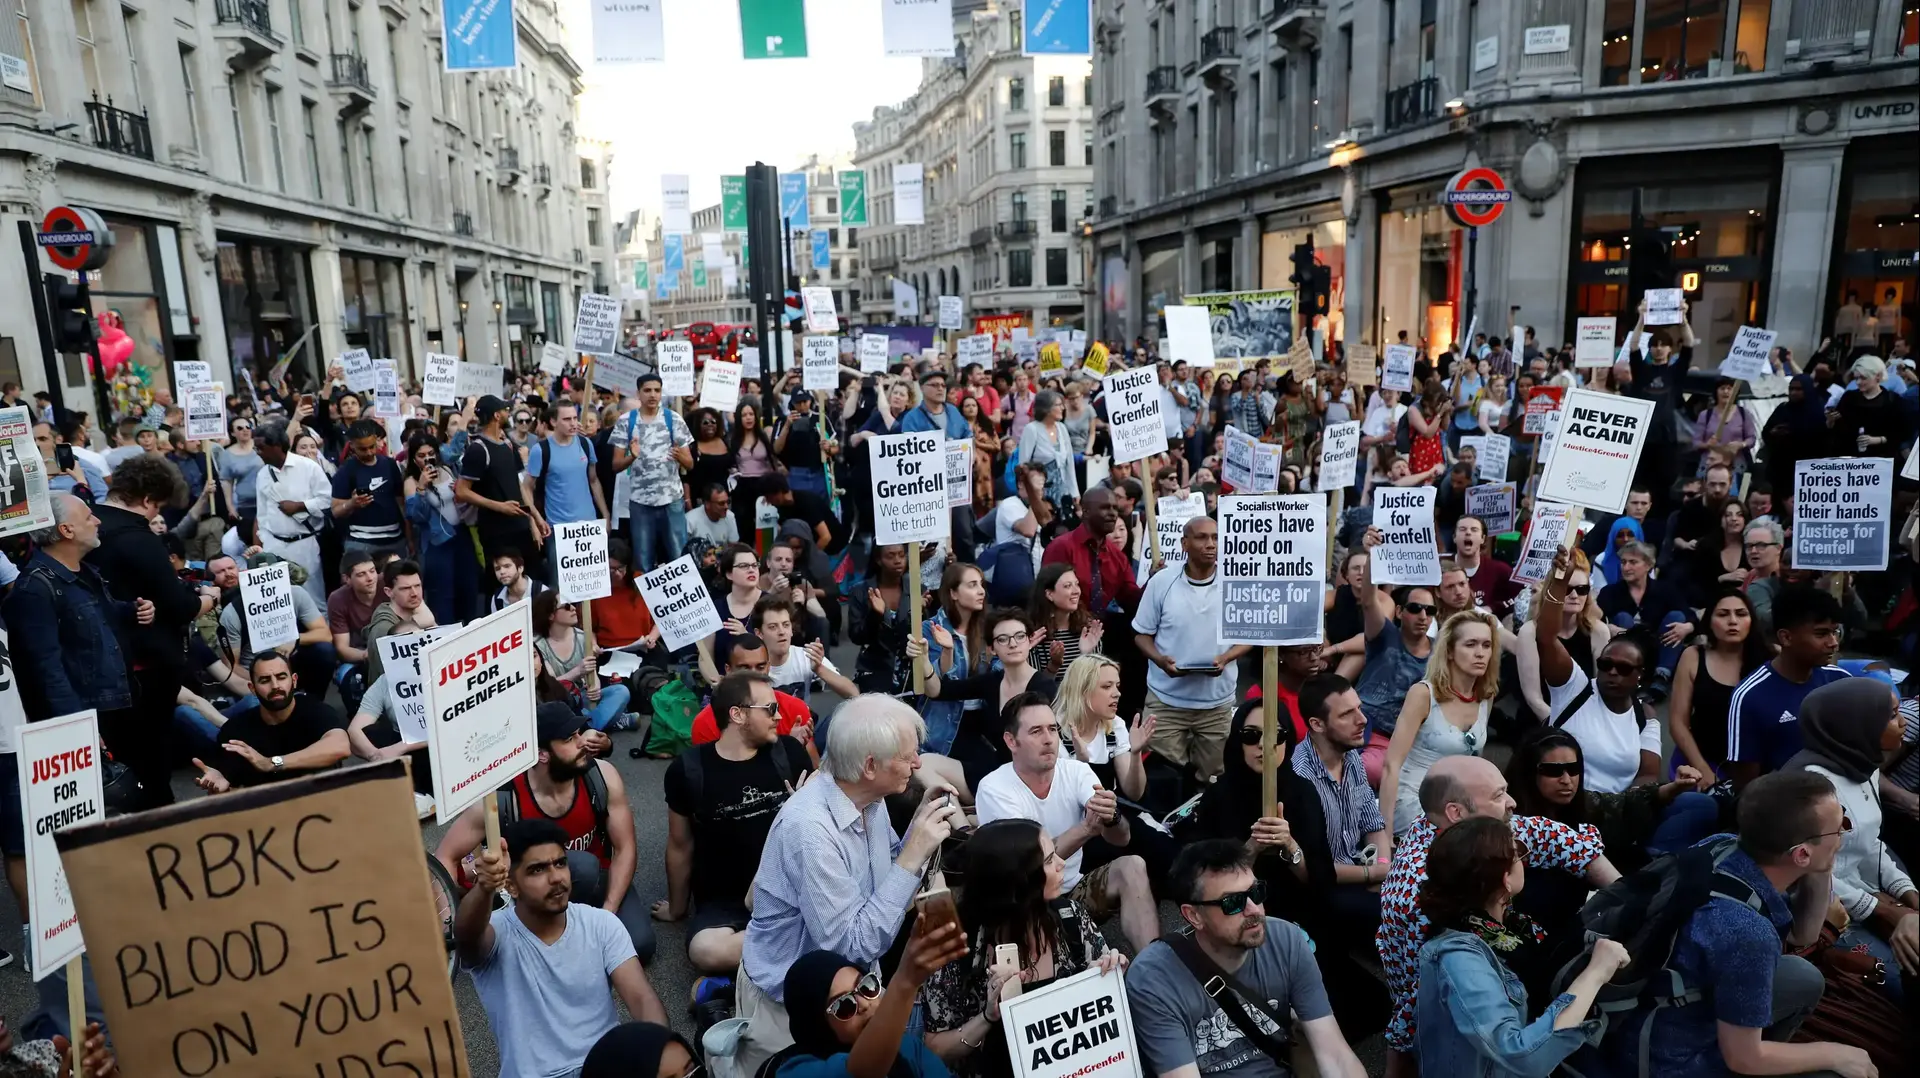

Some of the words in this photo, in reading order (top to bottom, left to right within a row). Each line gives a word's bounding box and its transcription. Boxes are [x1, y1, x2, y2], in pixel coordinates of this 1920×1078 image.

[1530, 29, 1556, 37] OXFORD
[1529, 37, 1553, 45] CIRCUS
[1855, 102, 1914, 119] UNITED
[1449, 193, 1511, 201] UNDERGROUND
[39, 233, 93, 243] UNDERGROUND
[1882, 258, 1911, 267] UNITE
[1605, 267, 1629, 275] UNITE
[580, 308, 598, 317] blood
[582, 299, 600, 310] Tories
[603, 302, 616, 312] have
[579, 317, 595, 326] their
[596, 319, 614, 329] hands
[578, 327, 600, 336] Justice
[602, 330, 611, 339] for
[1742, 328, 1771, 341] Justice
[577, 336, 602, 347] Grenfell
[663, 343, 688, 352] Justice
[807, 338, 834, 348] Justice
[1747, 339, 1760, 349] for
[343, 352, 365, 360] Justice
[430, 355, 454, 366] Justice
[671, 353, 681, 362] for
[814, 349, 827, 357] for
[1733, 346, 1767, 360] Grenfell
[180, 364, 206, 372] Justice
[346, 363, 372, 375] Grenfell
[661, 363, 691, 372] Grenfell
[805, 356, 836, 367] Grenfell
[437, 366, 447, 374] for
[709, 367, 737, 375] JUSTICE
[426, 373, 454, 384] Grenfell
[1111, 372, 1152, 394] Justice
[193, 393, 216, 401] JUSTICE
[1125, 391, 1143, 406] for
[190, 406, 220, 414] GRENFELL
[1112, 400, 1159, 426] Grenfell
[1572, 407, 1638, 429] NEVER
[0, 424, 26, 437] orker
[1115, 429, 1130, 440] We
[1131, 420, 1162, 437] demand
[1567, 422, 1634, 445] AGAIN
[879, 436, 936, 458] Justice
[1124, 440, 1138, 452] the
[1139, 434, 1157, 448] truth
[946, 452, 964, 462] STICE
[1563, 443, 1629, 460] #Justice4Grenfell
[896, 458, 922, 476] for
[947, 468, 966, 477] NFELL
[1845, 462, 1876, 470] Worker
[877, 472, 944, 498] Grenfell
[1799, 472, 1842, 487] Tories
[1847, 472, 1880, 486] have
[1380, 492, 1425, 509] Justice
[1476, 494, 1504, 502] JUSTICE
[1799, 488, 1837, 502] blood
[1842, 491, 1860, 502] on
[880, 502, 899, 517] We
[902, 496, 944, 514] demand
[1236, 502, 1276, 511] Socialist
[1276, 501, 1310, 511] Worker
[1472, 505, 1507, 514] GRENFELL
[1483, 500, 1498, 508] FOR
[1798, 504, 1832, 518] their
[1836, 504, 1878, 519] hands
[4, 510, 29, 520] STREETS
[1391, 510, 1410, 526] for
[891, 518, 908, 532] the
[912, 514, 936, 530] truth
[1157, 520, 1182, 533] ustic
[1224, 514, 1272, 534] Tories
[1278, 513, 1314, 533] have
[1541, 520, 1566, 530] JUSTICE
[1800, 522, 1848, 539] Justice
[1853, 523, 1876, 538] for
[562, 524, 602, 540] Justice
[1546, 529, 1559, 540] FOR
[575, 540, 592, 552] for
[1161, 534, 1177, 546] for
[1224, 535, 1268, 555] blood
[1273, 539, 1292, 554] on
[1800, 539, 1855, 555] Grenfell
[561, 551, 606, 570] Grenfell
[1144, 548, 1188, 560] Genfell
[1377, 548, 1394, 560] We
[1396, 548, 1434, 560] demand
[1222, 557, 1262, 576] their
[1266, 556, 1314, 576] hands
[1388, 562, 1404, 575] the
[1405, 562, 1428, 574] truth
[248, 568, 284, 587] Justice
[562, 572, 576, 583] We
[578, 568, 606, 581] demand
[644, 563, 690, 591] Justice
[260, 585, 276, 598] for
[570, 583, 583, 594] the
[584, 580, 602, 592] truth
[662, 582, 683, 599] for
[1224, 582, 1281, 603] Justice
[1286, 582, 1310, 603] for
[248, 592, 291, 616] Grenfell
[654, 585, 706, 620] Grenfell
[251, 620, 265, 630] We
[266, 612, 294, 626] demand
[661, 620, 678, 632] We
[678, 602, 711, 624] demand
[1224, 604, 1288, 624] Grenfell
[260, 629, 272, 640] the
[274, 624, 289, 636] truth
[674, 627, 689, 640] the
[688, 617, 710, 634] truth
[438, 630, 523, 687] JUSTICE
[466, 664, 500, 691] FOR
[442, 670, 524, 723] GRENFELL
[402, 702, 424, 717] We
[32, 746, 93, 785] JUSTICE
[451, 741, 528, 794] #Justice4Grenfell
[53, 780, 78, 804] FOR
[36, 799, 96, 836] GRENFELL
[145, 813, 340, 912] RBKC
[44, 913, 78, 940] #Justice4
[115, 920, 289, 1010] BLOOD
[309, 899, 386, 964] IS
[172, 1010, 258, 1078] ON
[279, 962, 422, 1048] YOUR
[1025, 995, 1115, 1044] NEVER
[1031, 1018, 1120, 1071] AGAIN
